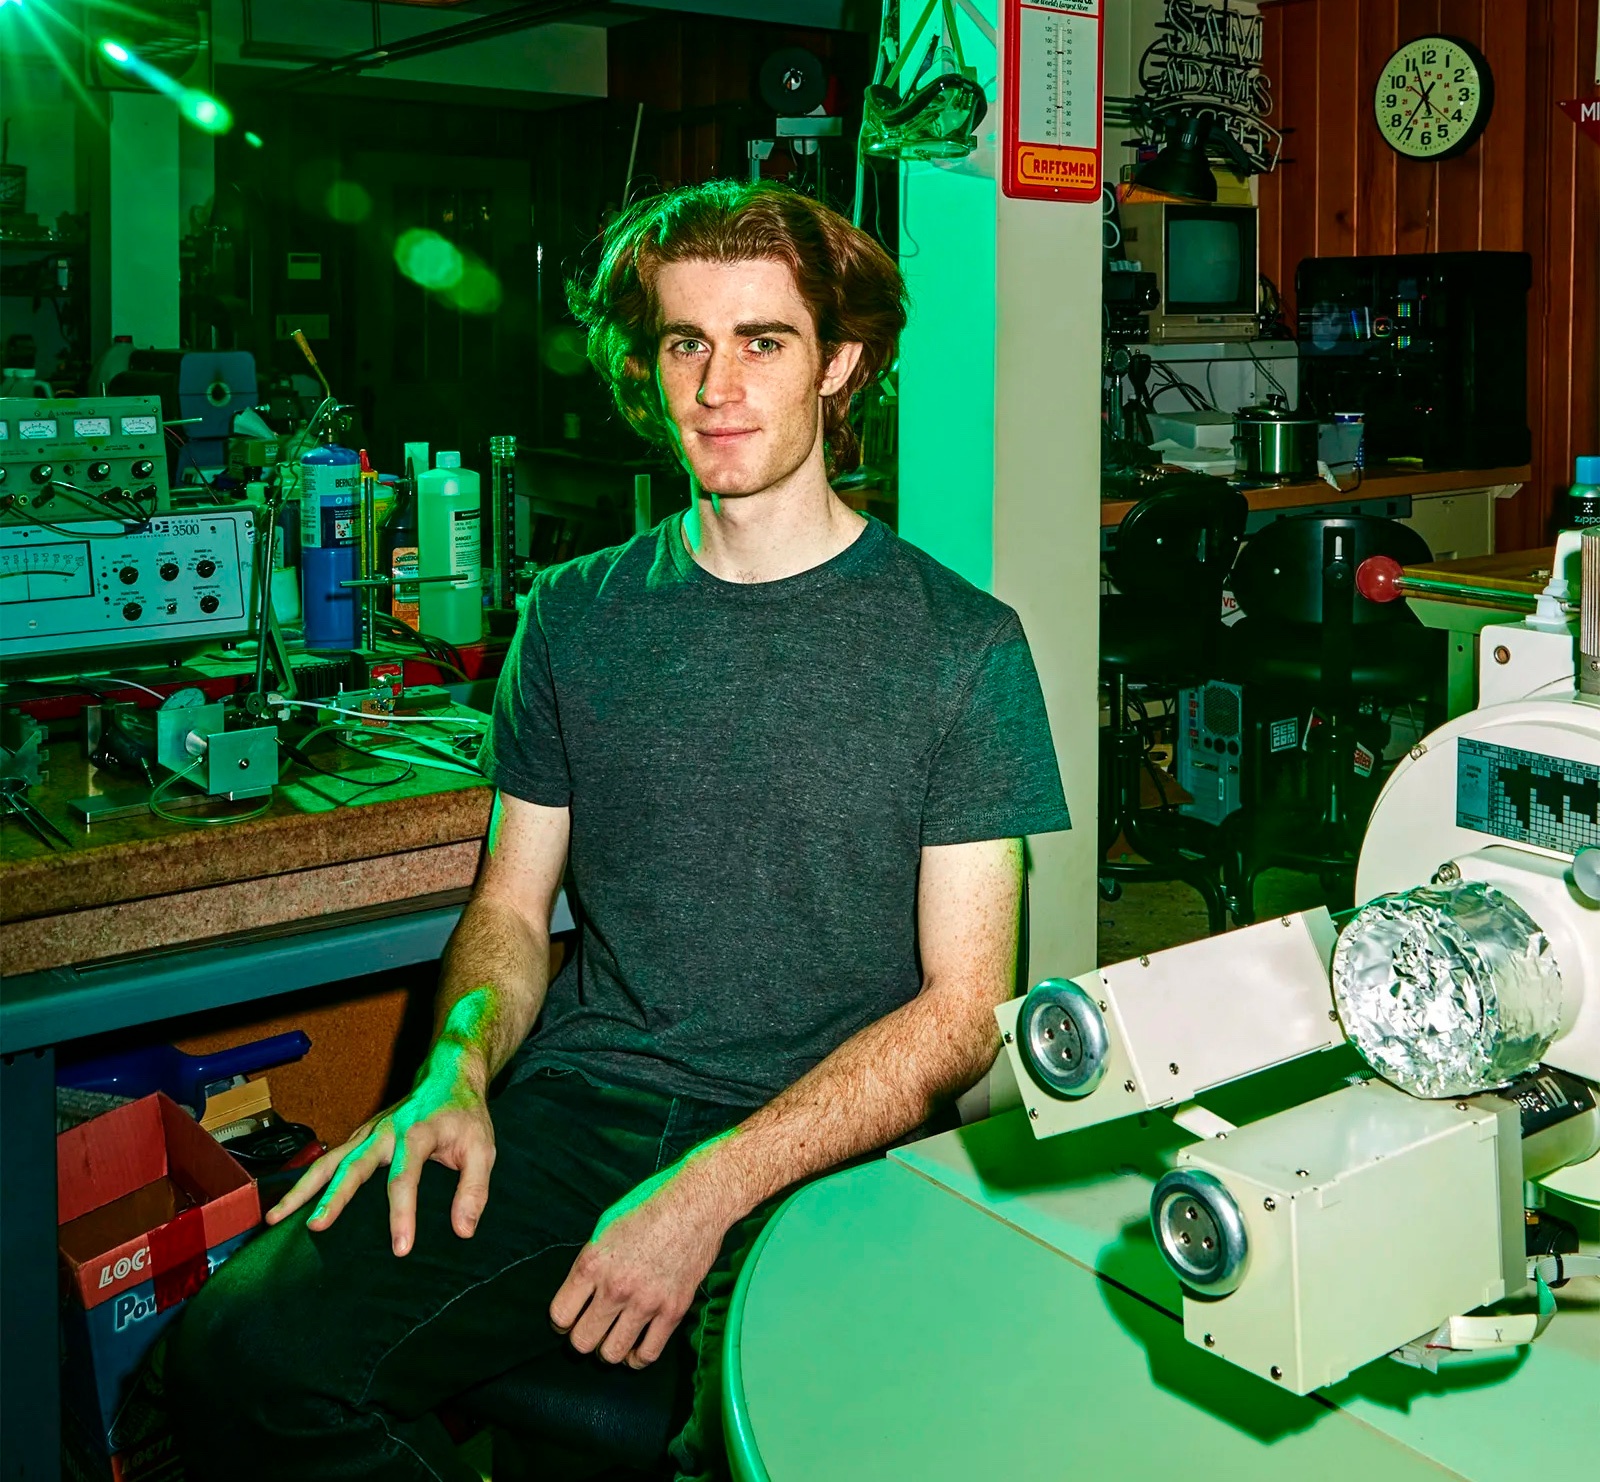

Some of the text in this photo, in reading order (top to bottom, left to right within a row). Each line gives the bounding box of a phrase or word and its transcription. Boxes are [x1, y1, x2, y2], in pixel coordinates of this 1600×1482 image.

[1058, 1, 1076, 10] Largest
[1166, 0, 1264, 64] SAM
[1422, 50, 1436, 64] 12
[1446, 54, 1450, 68] 1
[1406, 58, 1416, 72] 11
[1391, 75, 1406, 89] 10
[1454, 69, 1465, 82] 2
[1156, 57, 1273, 117] ADAMS
[1386, 94, 1396, 108] 9
[1459, 88, 1469, 101] 3
[1391, 114, 1402, 127] 8
[1451, 109, 1463, 122] 4
[1405, 127, 1413, 140] 7
[1437, 124, 1448, 138] 5
[1421, 132, 1431, 145] 6
[1020, 152, 1094, 180] CRAFTSMAN
[172, 524, 199, 536] 3500
[1223, 596, 1236, 608] VC
[1273, 722, 1295, 737] SES
[1518, 1096, 1535, 1109] 50
[1495, 1328, 1503, 1342] X
